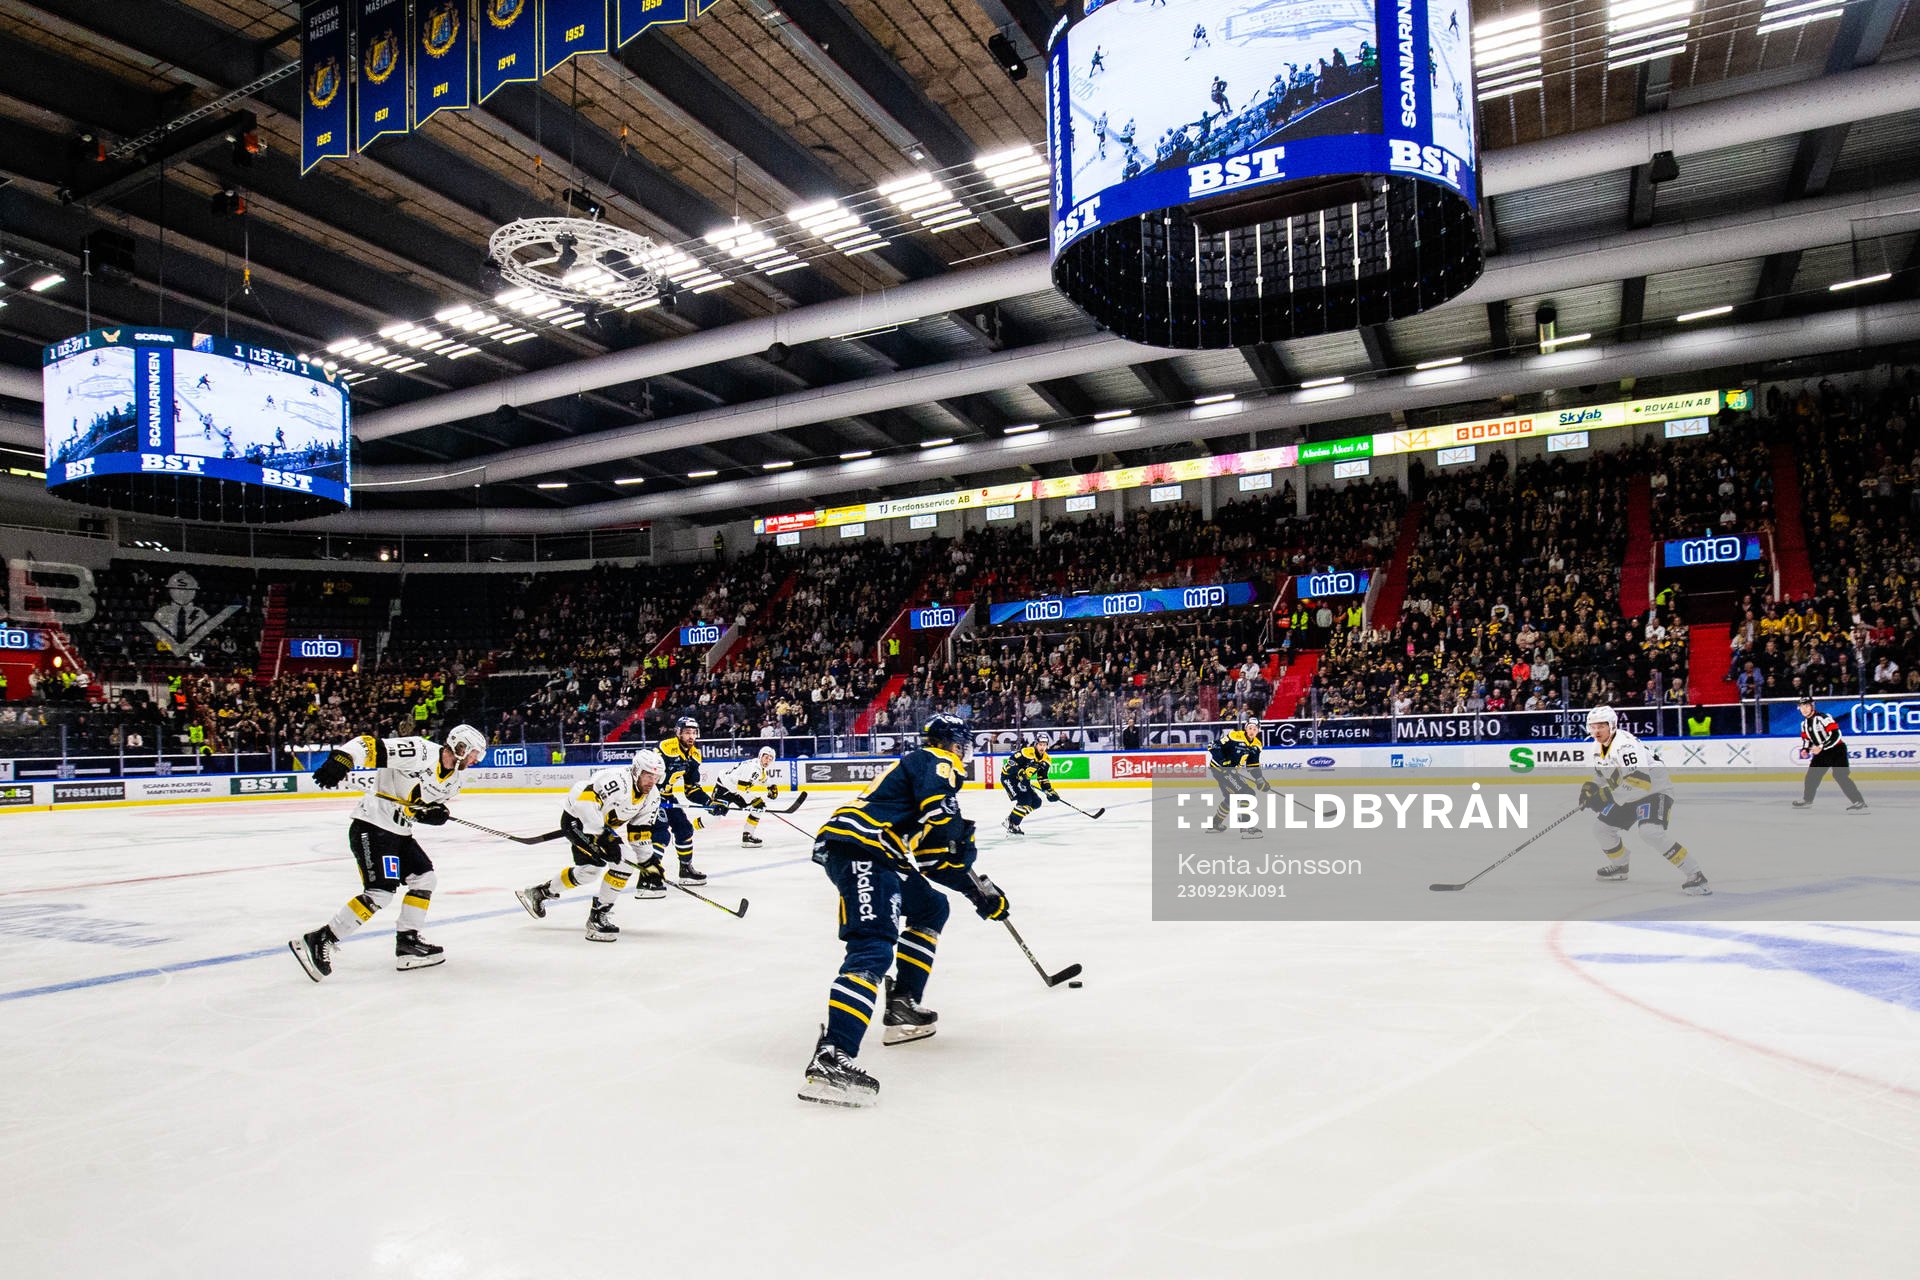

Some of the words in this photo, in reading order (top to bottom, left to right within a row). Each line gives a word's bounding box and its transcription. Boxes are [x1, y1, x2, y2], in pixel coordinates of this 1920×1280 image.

[309, 5, 340, 28] SVENSKA
[309, 19, 340, 41] MÄSTARE
[565, 24, 584, 42] 1953
[498, 53, 516, 71] 1944
[433, 81, 449, 98] 1941
[374, 107, 389, 123] 1931
[1188, 146, 1285, 192] BST
[1389, 139, 1461, 182] BST
[1054, 196, 1101, 248] BST
[134, 333, 175, 342] SCANIA
[234, 345, 245, 357] 1
[300, 363, 310, 375] 1
[148, 352, 161, 448] SCANIARINKEN
[1645, 400, 1693, 413] ROVALIN
[1696, 398, 1711, 406] AB
[1457, 419, 1533, 440] CRAMO
[1356, 442, 1369, 451] AB
[1394, 430, 1426, 451] N4
[65, 458, 94, 477] BST
[142, 454, 205, 472] BST
[262, 468, 312, 489] BST
[878, 505, 888, 514] TJ
[892, 498, 955, 512] Fordonsservice
[957, 495, 970, 504] AB
[1300, 728, 1370, 739] FÖRETAGEN
[1397, 718, 1500, 738] MÅNSBRO
[397, 741, 416, 758] 20
[1865, 747, 1917, 759] Resor
[1309, 758, 1333, 767] Carrier
[1509, 747, 1584, 773] SIMAB
[1622, 752, 1638, 766] 66
[56, 786, 123, 798] TYSSLINGE
[240, 777, 288, 790] BST
[604, 780, 620, 796] 91
[854, 861, 877, 921] Dialect
